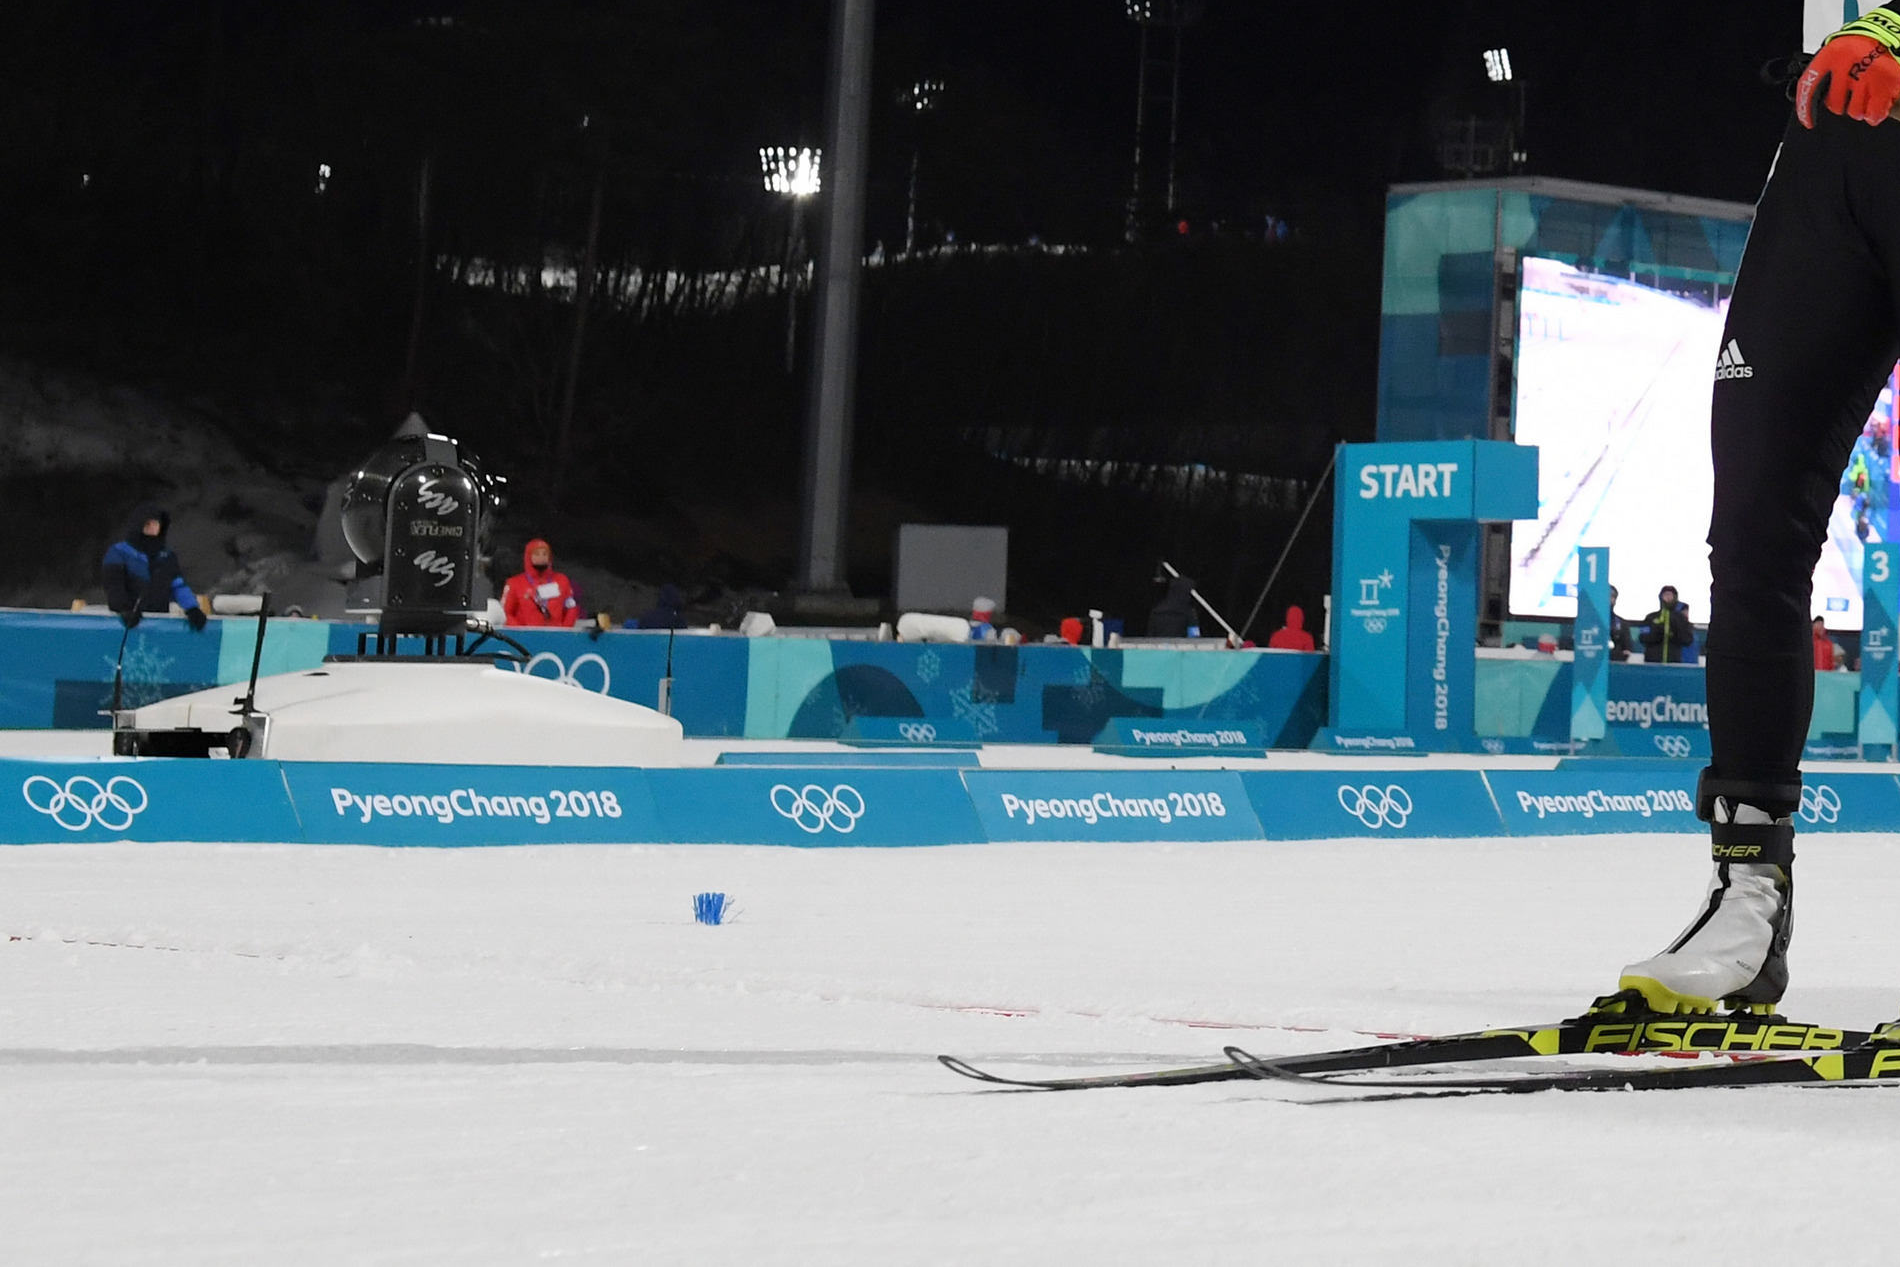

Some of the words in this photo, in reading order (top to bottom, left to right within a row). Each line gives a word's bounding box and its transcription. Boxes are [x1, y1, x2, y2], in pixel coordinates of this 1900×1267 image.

[1848, 44, 1888, 82] ROEC
[1359, 462, 1458, 499] START
[1586, 553, 1598, 583] 1
[1869, 550, 1890, 583] 3
[1432, 544, 1452, 682] PyeongChang
[1433, 684, 1449, 731] 2018
[1605, 695, 1709, 730] eongChan
[331, 787, 550, 825] PyeongChang
[549, 790, 623, 818] 2018
[1000, 792, 1172, 825] PyeongChang
[1172, 792, 1226, 817] 2018
[1516, 789, 1650, 819] PyeongChang
[1650, 790, 1694, 816] 2018
[1712, 844, 1762, 857] CHER
[1584, 1022, 1844, 1053] FISCHER
